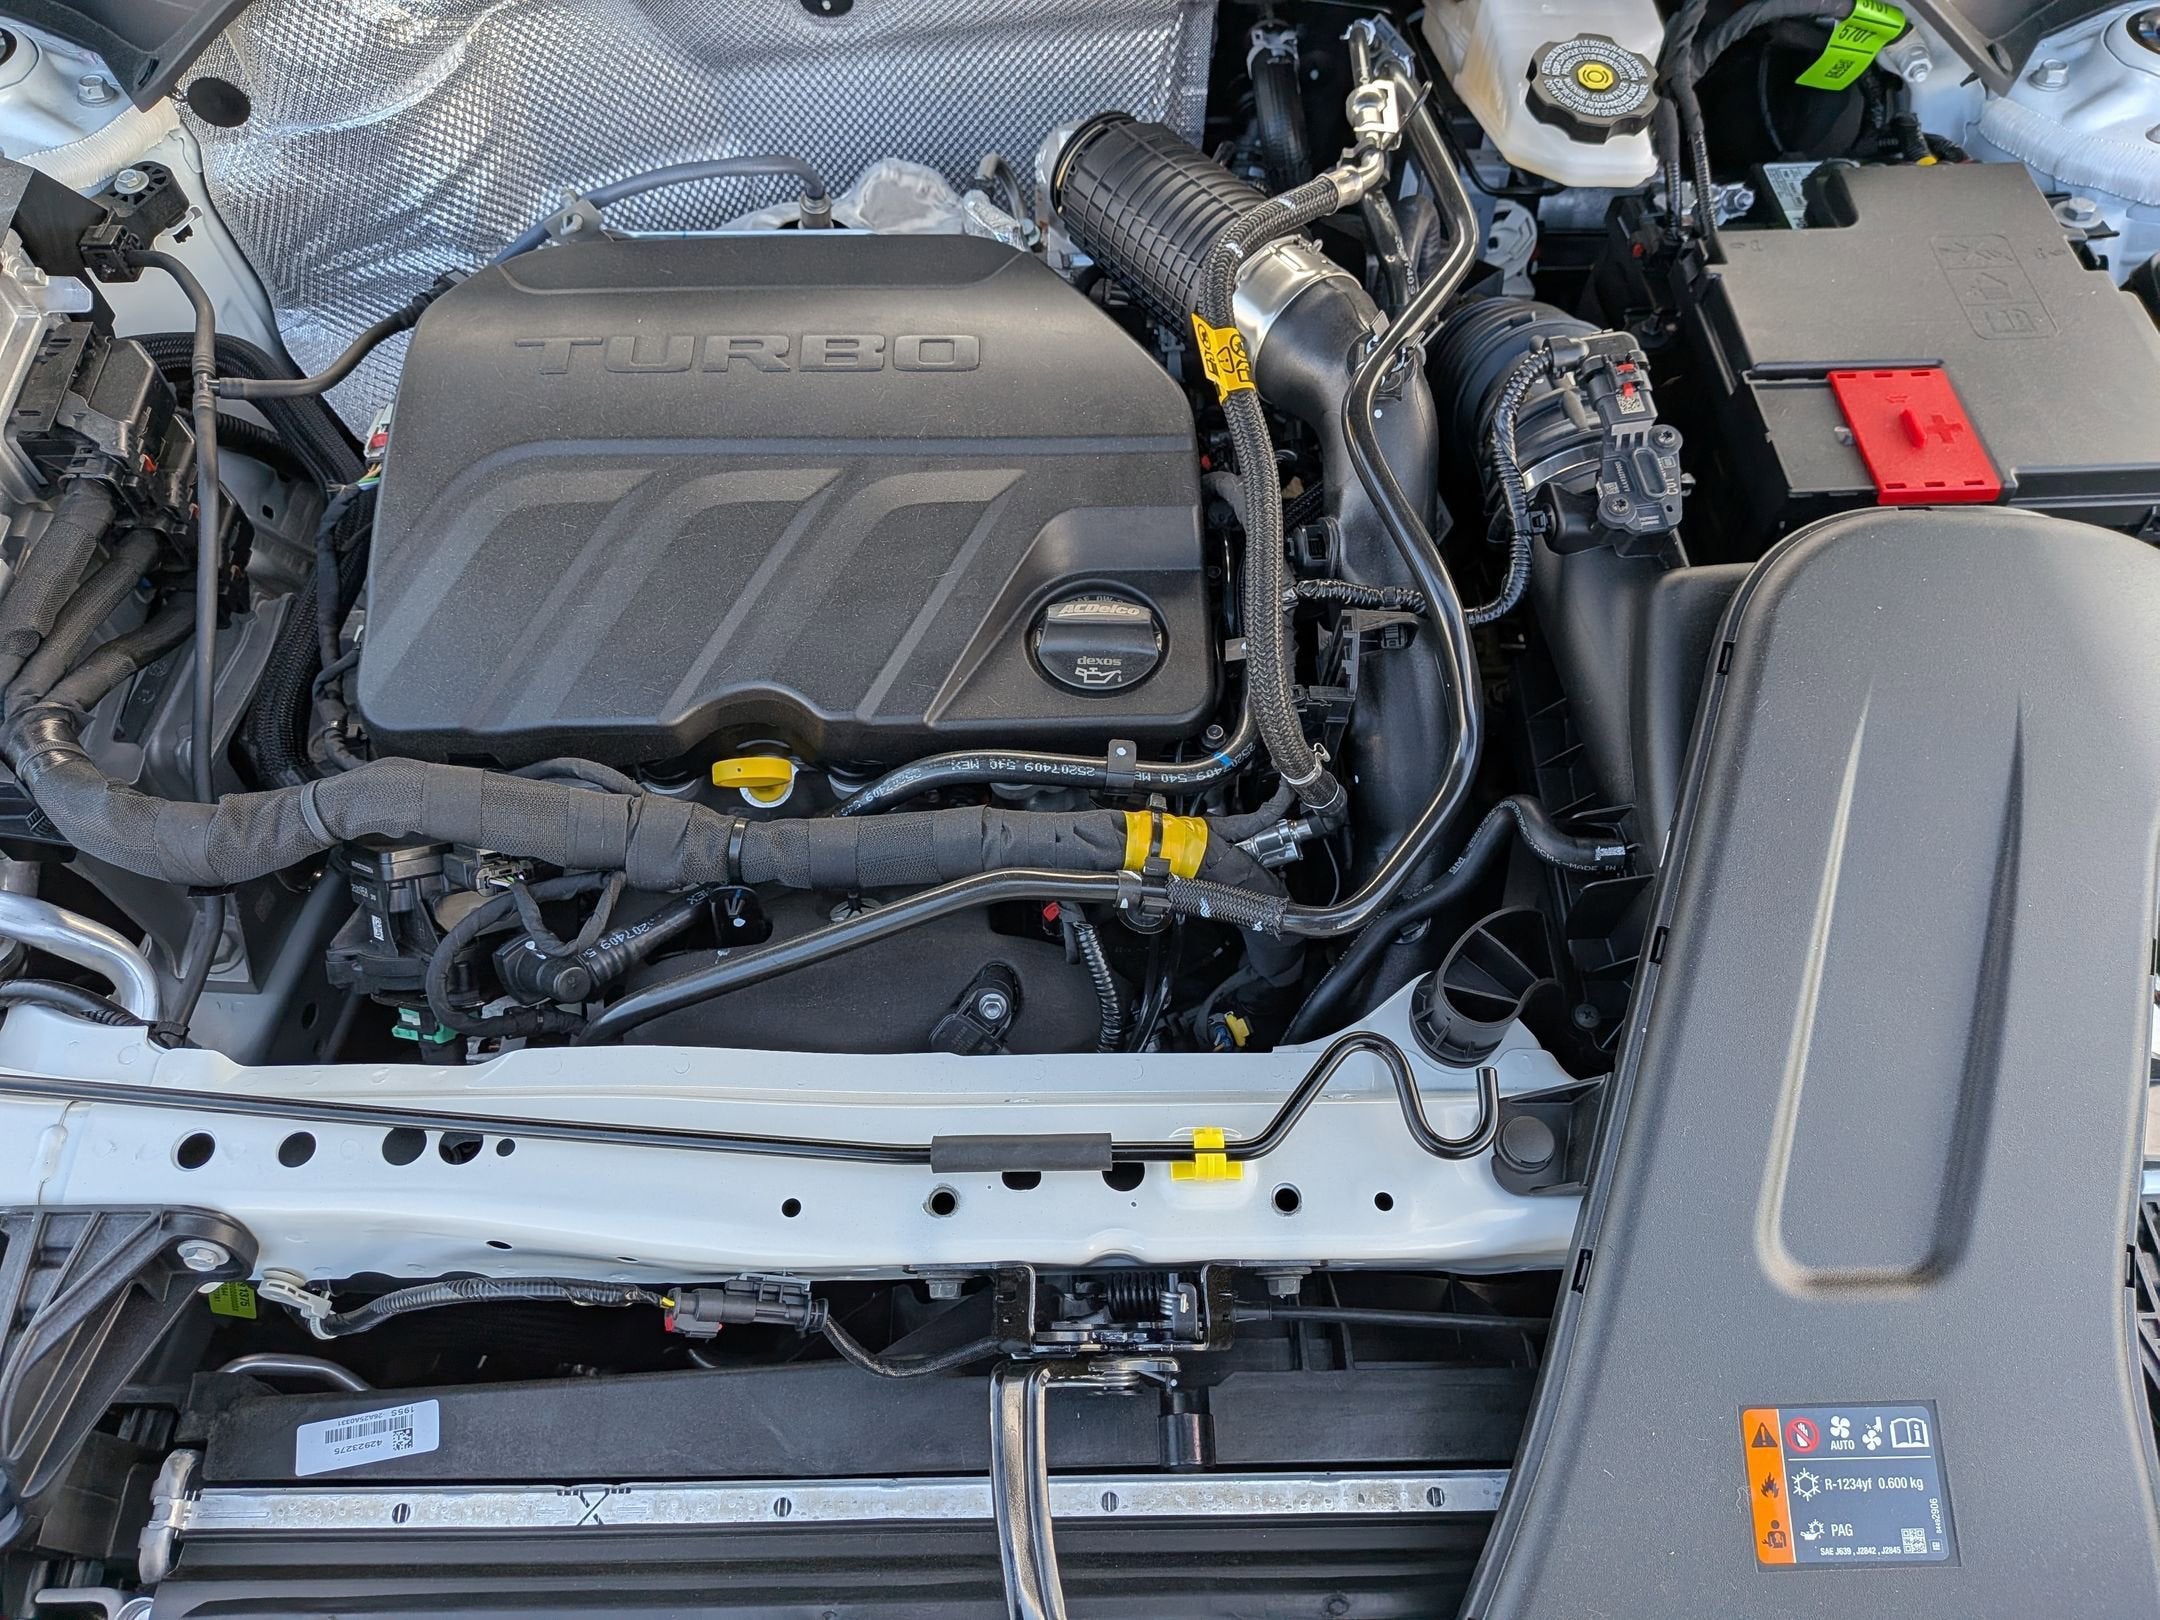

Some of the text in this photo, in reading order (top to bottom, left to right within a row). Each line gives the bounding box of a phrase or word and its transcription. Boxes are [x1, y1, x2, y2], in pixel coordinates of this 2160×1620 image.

[1839, 24, 1877, 43] 5707
[1573, 103, 1595, 115] FROM
[514, 334, 981, 375] TURBO
[1058, 603, 1141, 616] ACDelco
[1076, 655, 1122, 666] dexos
[951, 758, 980, 771] MEX
[988, 758, 1017, 772] 540
[1024, 761, 1097, 777] 25207409
[1134, 770, 1151, 782] ME
[1160, 773, 1189, 784] 540
[599, 917, 657, 951] 207409
[334, 1440, 383, 1455] 42923275
[1830, 1439, 1856, 1450] AUTO
[1824, 1476, 1924, 1492] R-1234yf 0.600 kg
[1831, 1523, 1854, 1537] PAG
[1820, 1547, 1834, 1556] SAE
